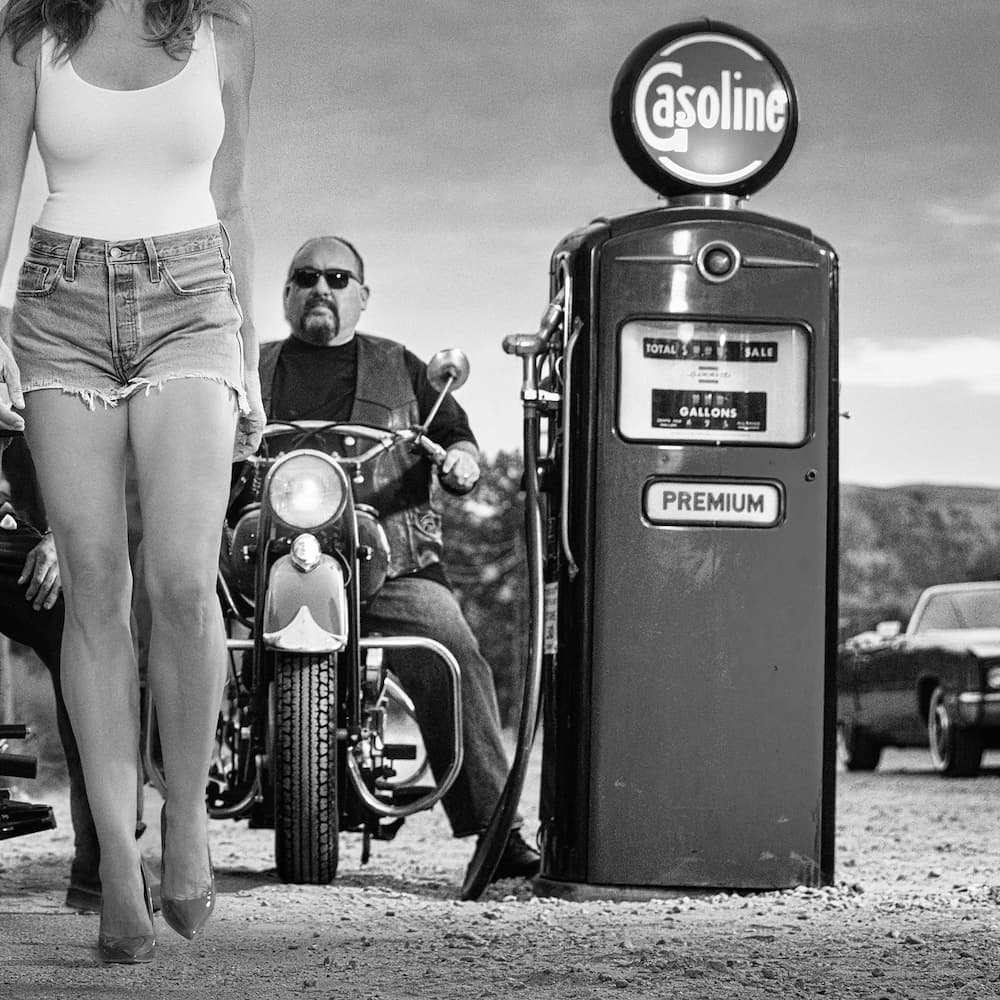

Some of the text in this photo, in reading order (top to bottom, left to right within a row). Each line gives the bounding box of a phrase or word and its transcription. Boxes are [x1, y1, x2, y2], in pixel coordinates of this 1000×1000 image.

[634, 61, 789, 153] Gasoline
[646, 343, 677, 354] TOTAL
[745, 346, 774, 358] SALE
[679, 406, 738, 418] GALLONS
[662, 490, 765, 514] PREMIUM
